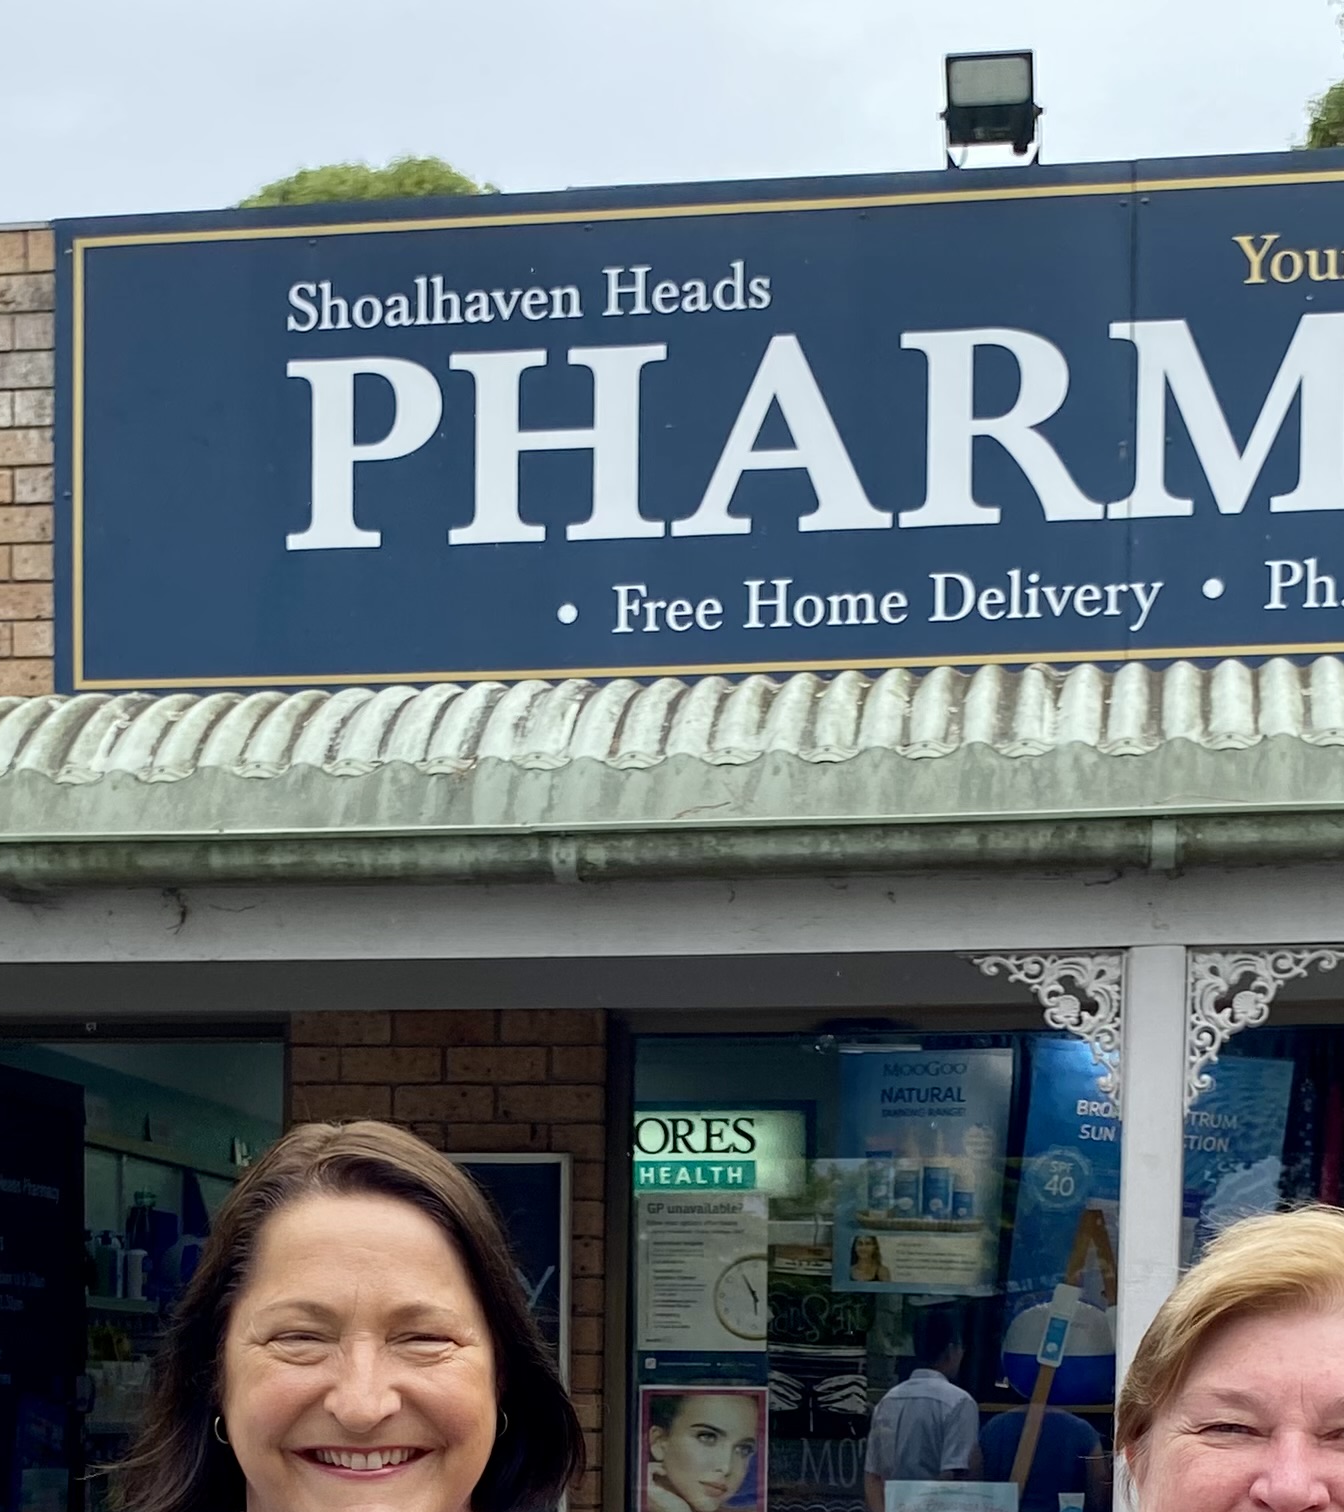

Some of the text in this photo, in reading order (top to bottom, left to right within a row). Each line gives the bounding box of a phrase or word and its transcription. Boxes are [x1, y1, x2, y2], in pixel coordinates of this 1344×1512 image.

[286, 260, 771, 332] Shoalhaven Heads
[610, 584, 723, 633] Free
[742, 579, 908, 629] Home
[928, 568, 1164, 632] Delivery
[881, 1086, 967, 1103] NATURAL
[1187, 1110, 1240, 1130] TRUM
[635, 1118, 756, 1154] ORES
[1078, 1123, 1231, 1153] SUN TION
[639, 1166, 744, 1185] HEALTH
[1049, 1159, 1075, 1174] SPF
[1043, 1176, 1076, 1198] 40
[647, 1203, 744, 1215] GP unavailable?
